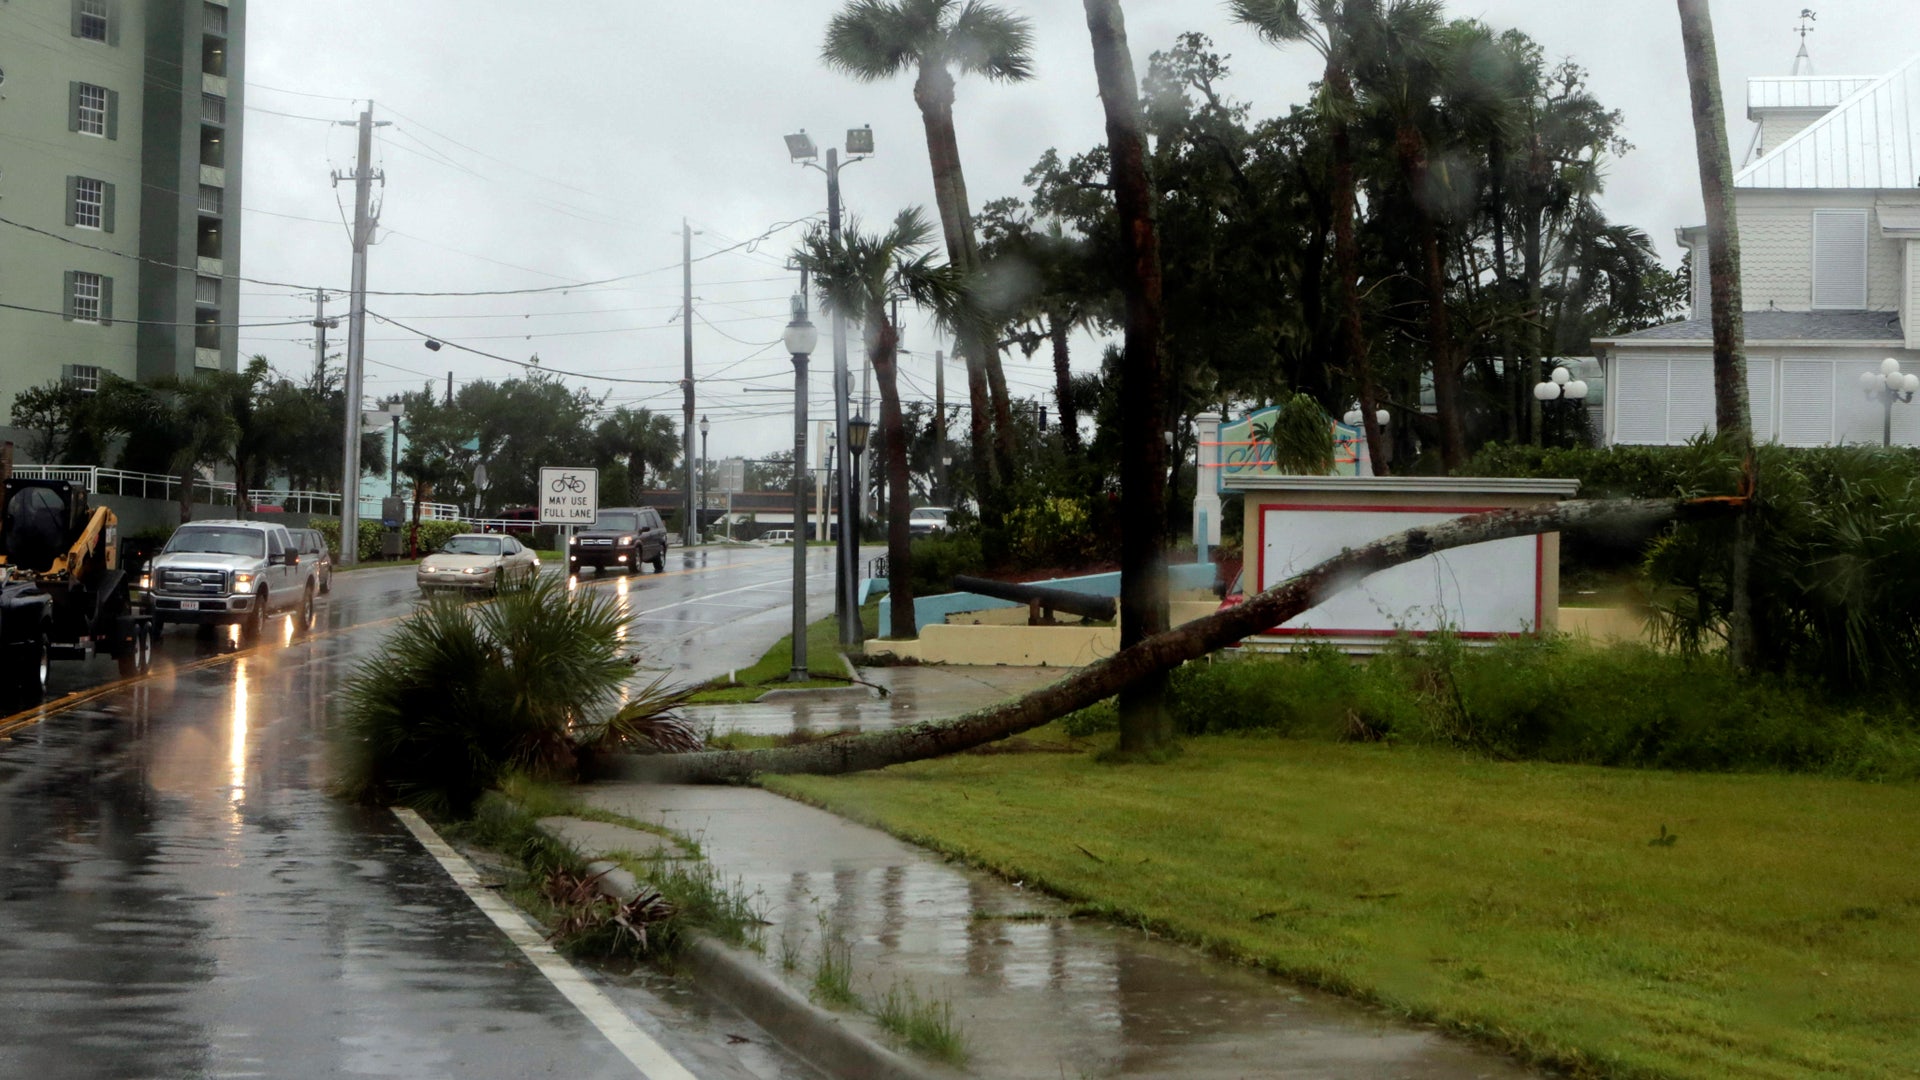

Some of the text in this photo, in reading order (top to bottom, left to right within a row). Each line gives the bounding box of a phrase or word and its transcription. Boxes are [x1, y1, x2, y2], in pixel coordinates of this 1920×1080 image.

[549, 496, 587, 505] MAY USE
[544, 508, 591, 518] FULL LANE
